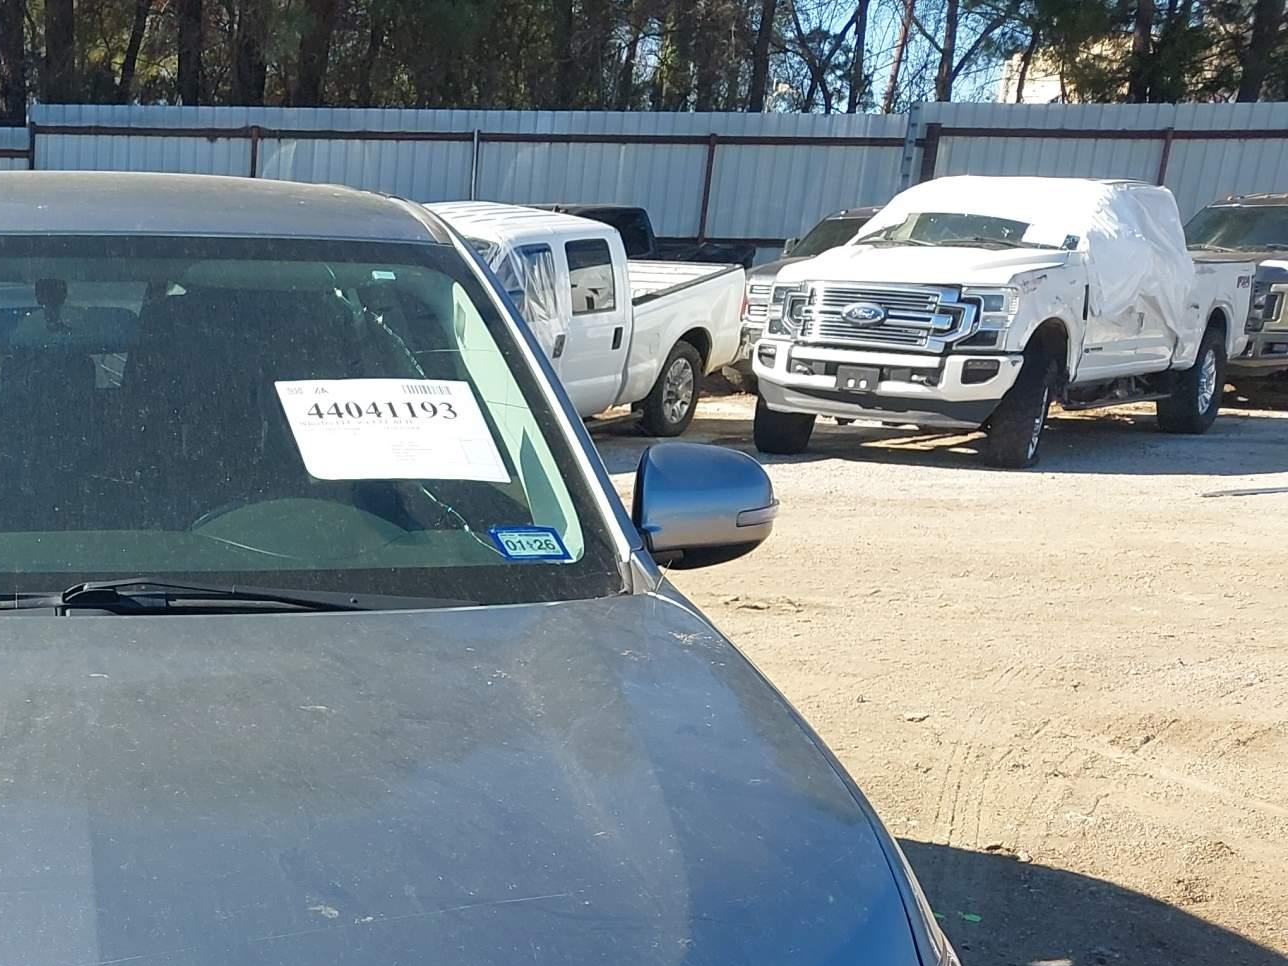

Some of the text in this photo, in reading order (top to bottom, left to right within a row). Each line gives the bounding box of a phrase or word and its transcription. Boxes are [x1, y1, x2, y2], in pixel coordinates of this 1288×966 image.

[850, 307, 876, 319] Ford
[307, 400, 458, 420] 44041193
[505, 538, 556, 551] 01 26
